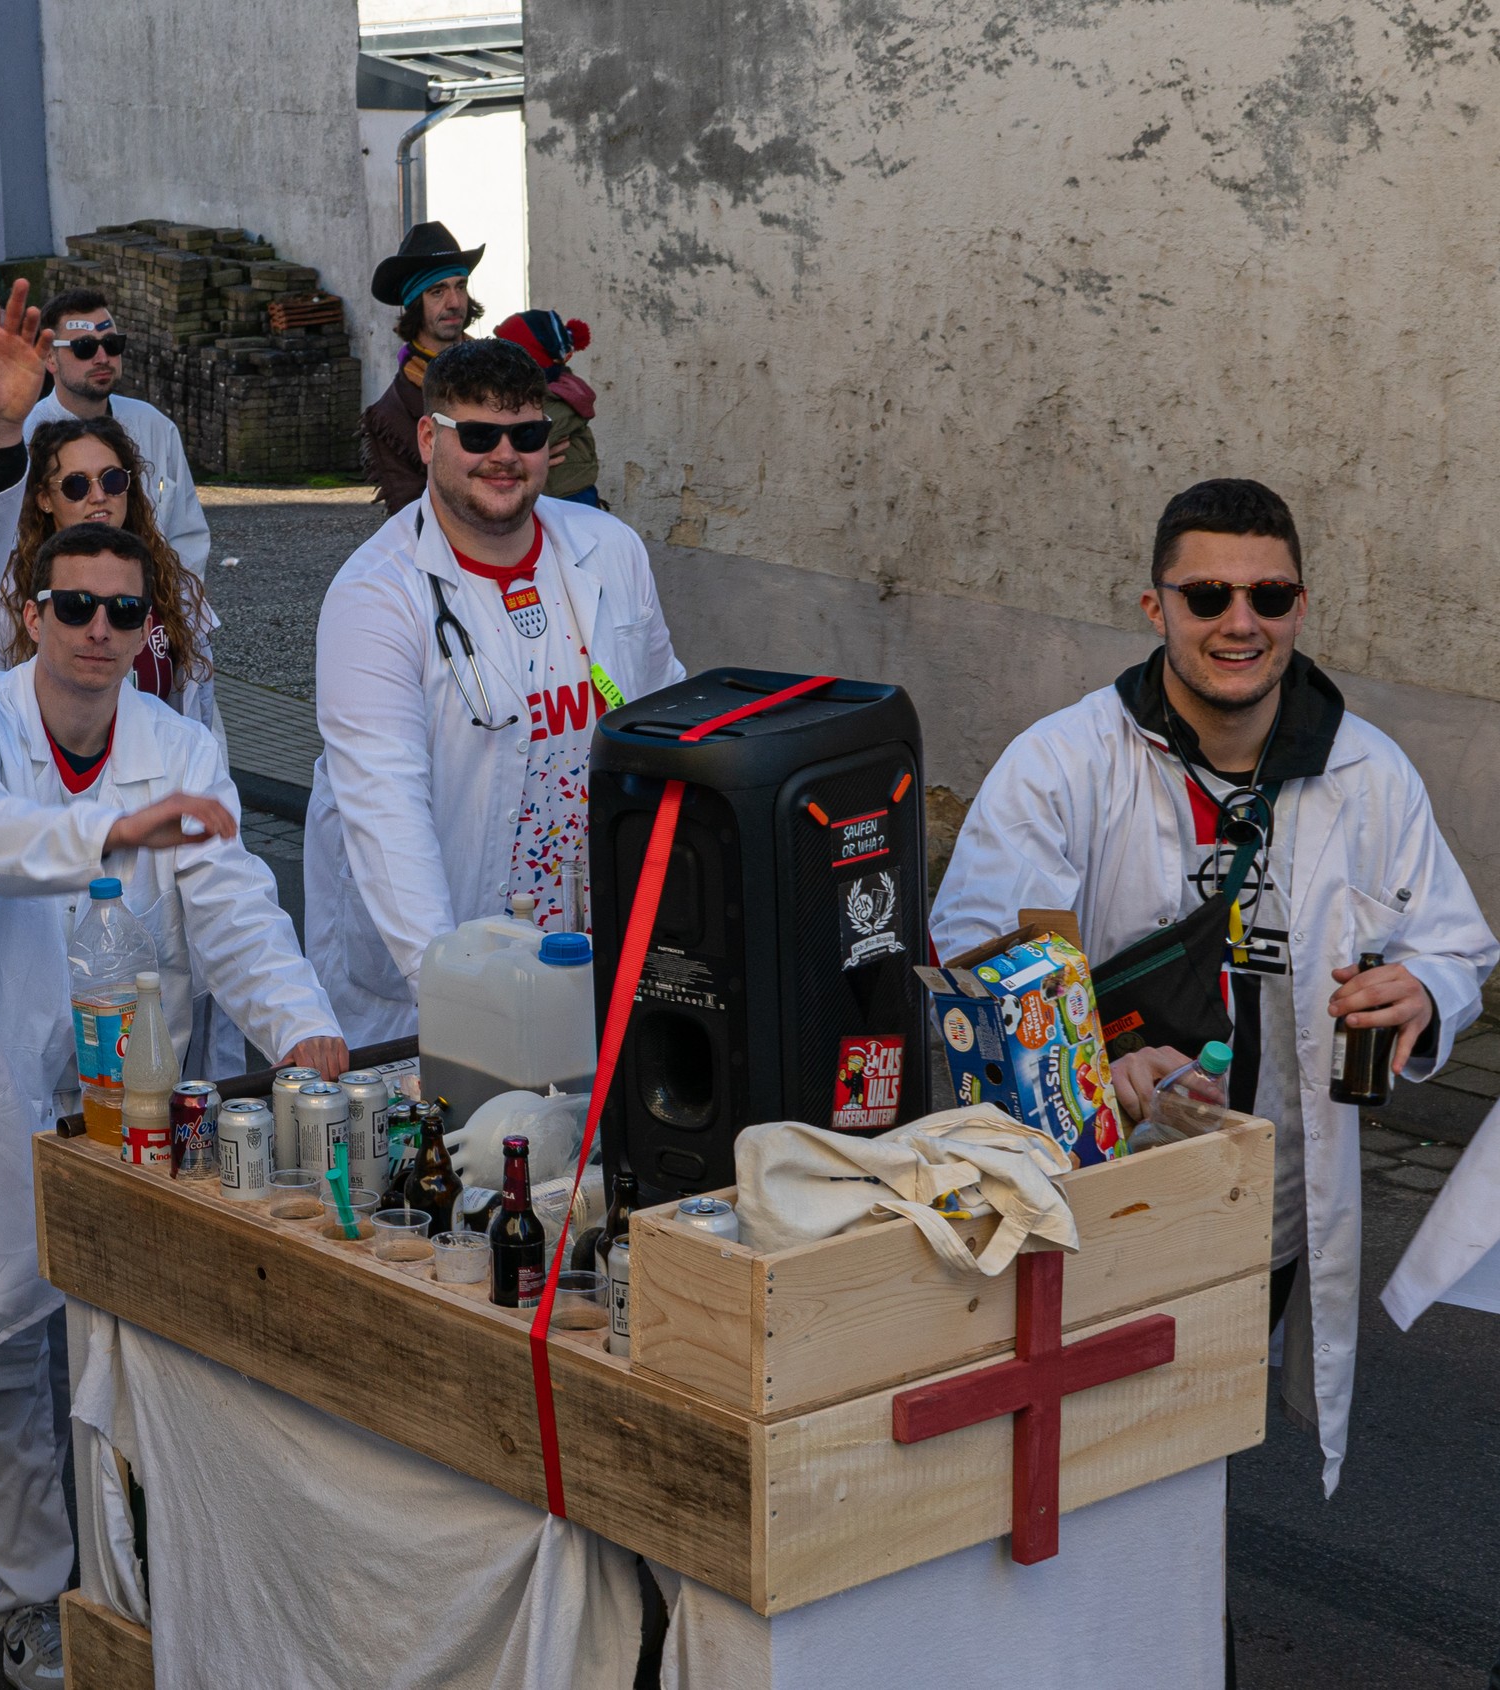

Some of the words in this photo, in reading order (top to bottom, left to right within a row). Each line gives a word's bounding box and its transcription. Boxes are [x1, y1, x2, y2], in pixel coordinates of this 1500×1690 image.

[843, 818, 878, 840] SAUFEN
[841, 843, 856, 858] OR
[1045, 1045, 1079, 1146] Capri-Sun
[190, 1140, 213, 1150] COLA
